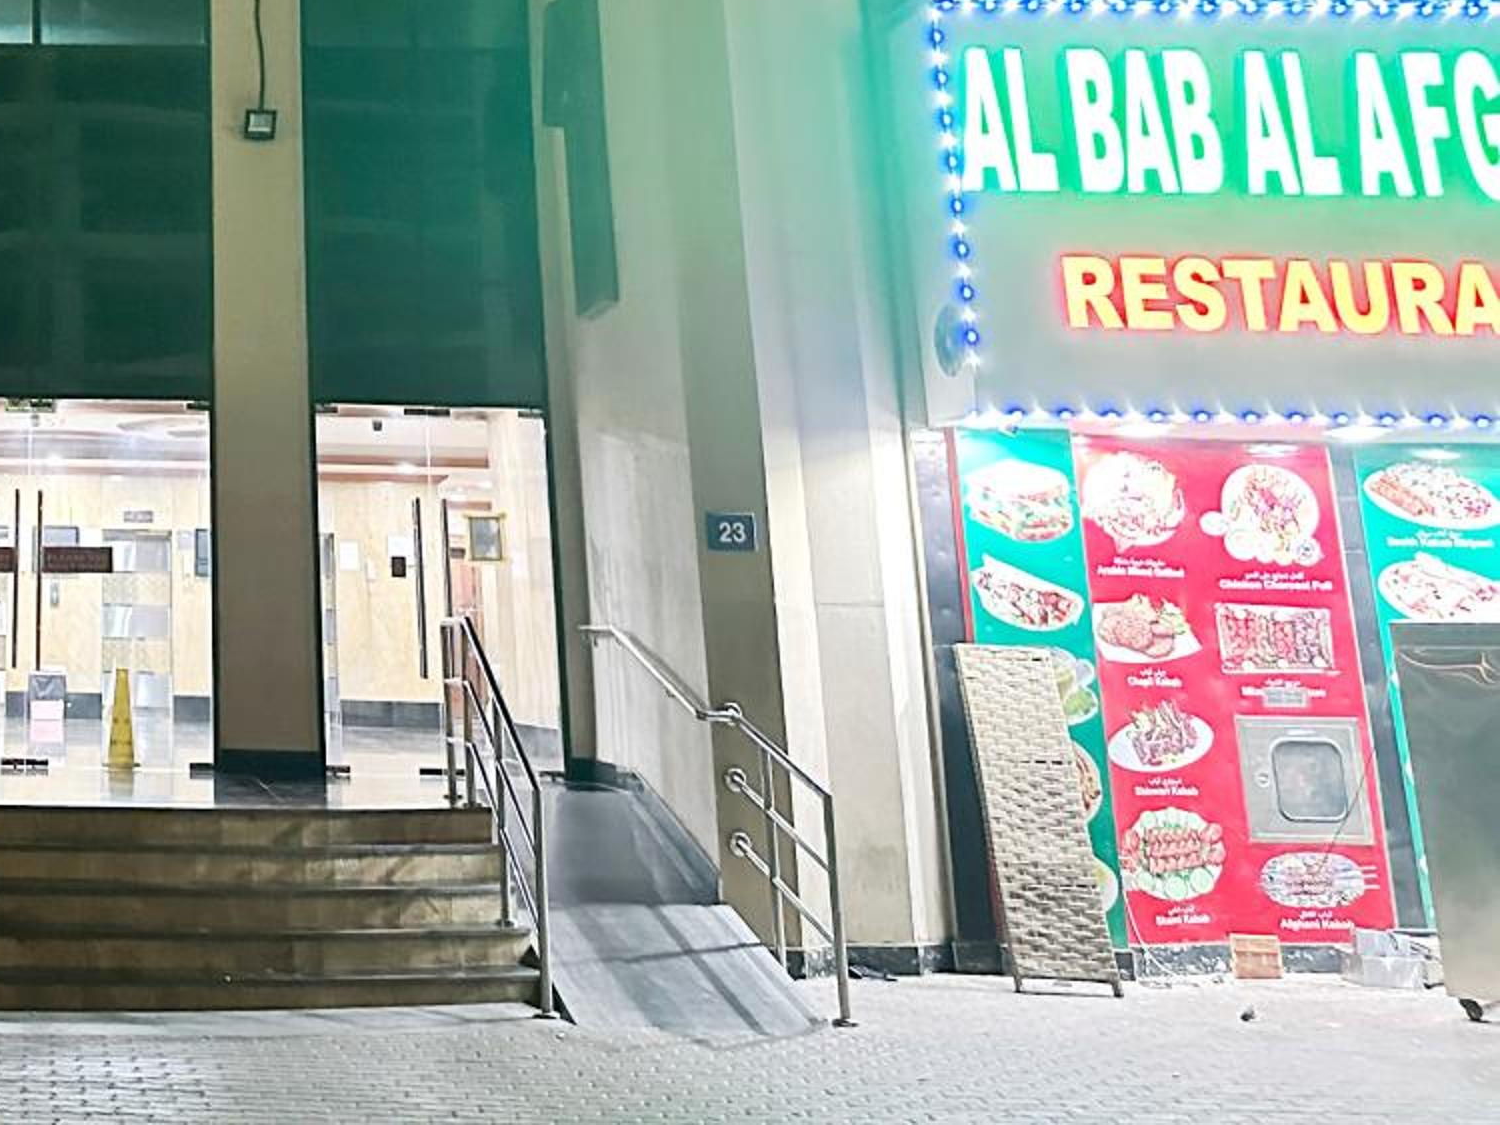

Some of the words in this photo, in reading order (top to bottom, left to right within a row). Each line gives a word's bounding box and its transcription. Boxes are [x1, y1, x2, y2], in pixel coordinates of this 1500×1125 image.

[964, 47, 1060, 192] AL
[1065, 47, 1225, 194] BAB
[1244, 50, 1343, 195] AL
[1060, 253, 1500, 337] RESTAURA
[719, 522, 747, 543] 23
